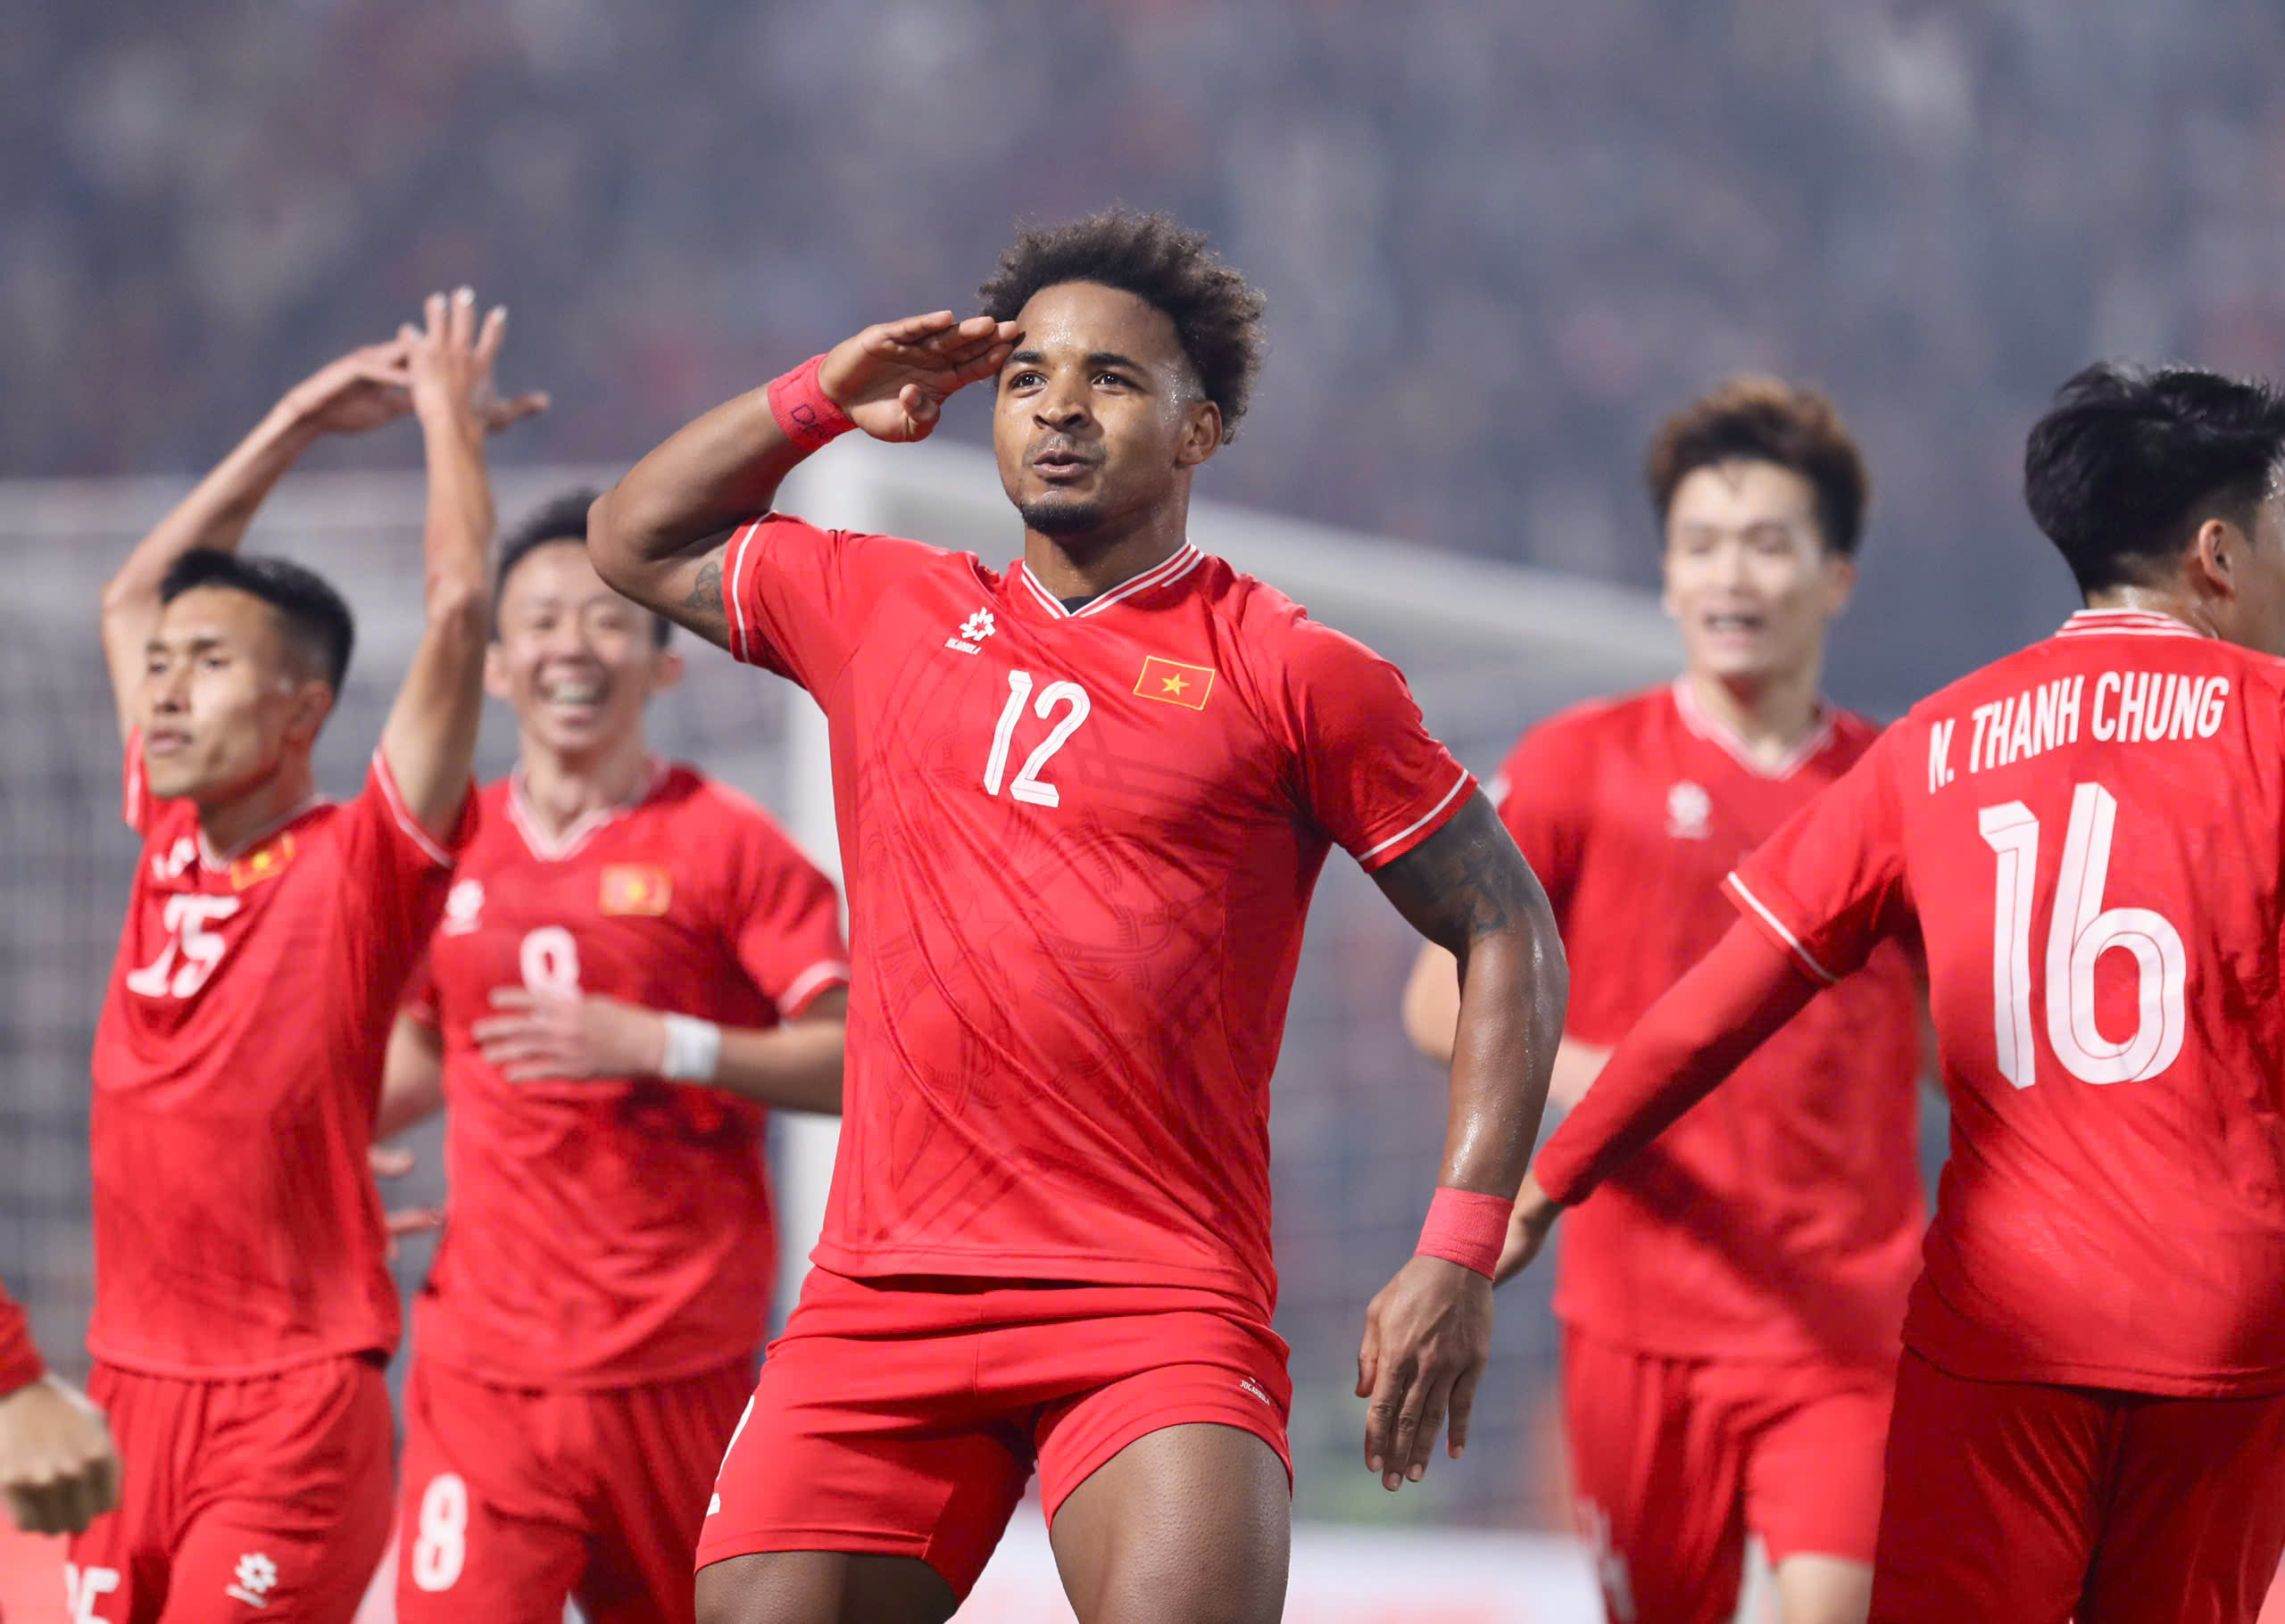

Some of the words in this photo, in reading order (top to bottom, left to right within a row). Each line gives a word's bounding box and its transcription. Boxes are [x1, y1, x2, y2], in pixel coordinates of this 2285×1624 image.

[984, 669, 1091, 808] 12
[1928, 717, 1956, 794] N.
[1969, 674, 2085, 775] THANH
[2091, 670, 2231, 742] CHUNG
[1978, 781, 2187, 1090] 16
[411, 1471, 469, 1592] 8
